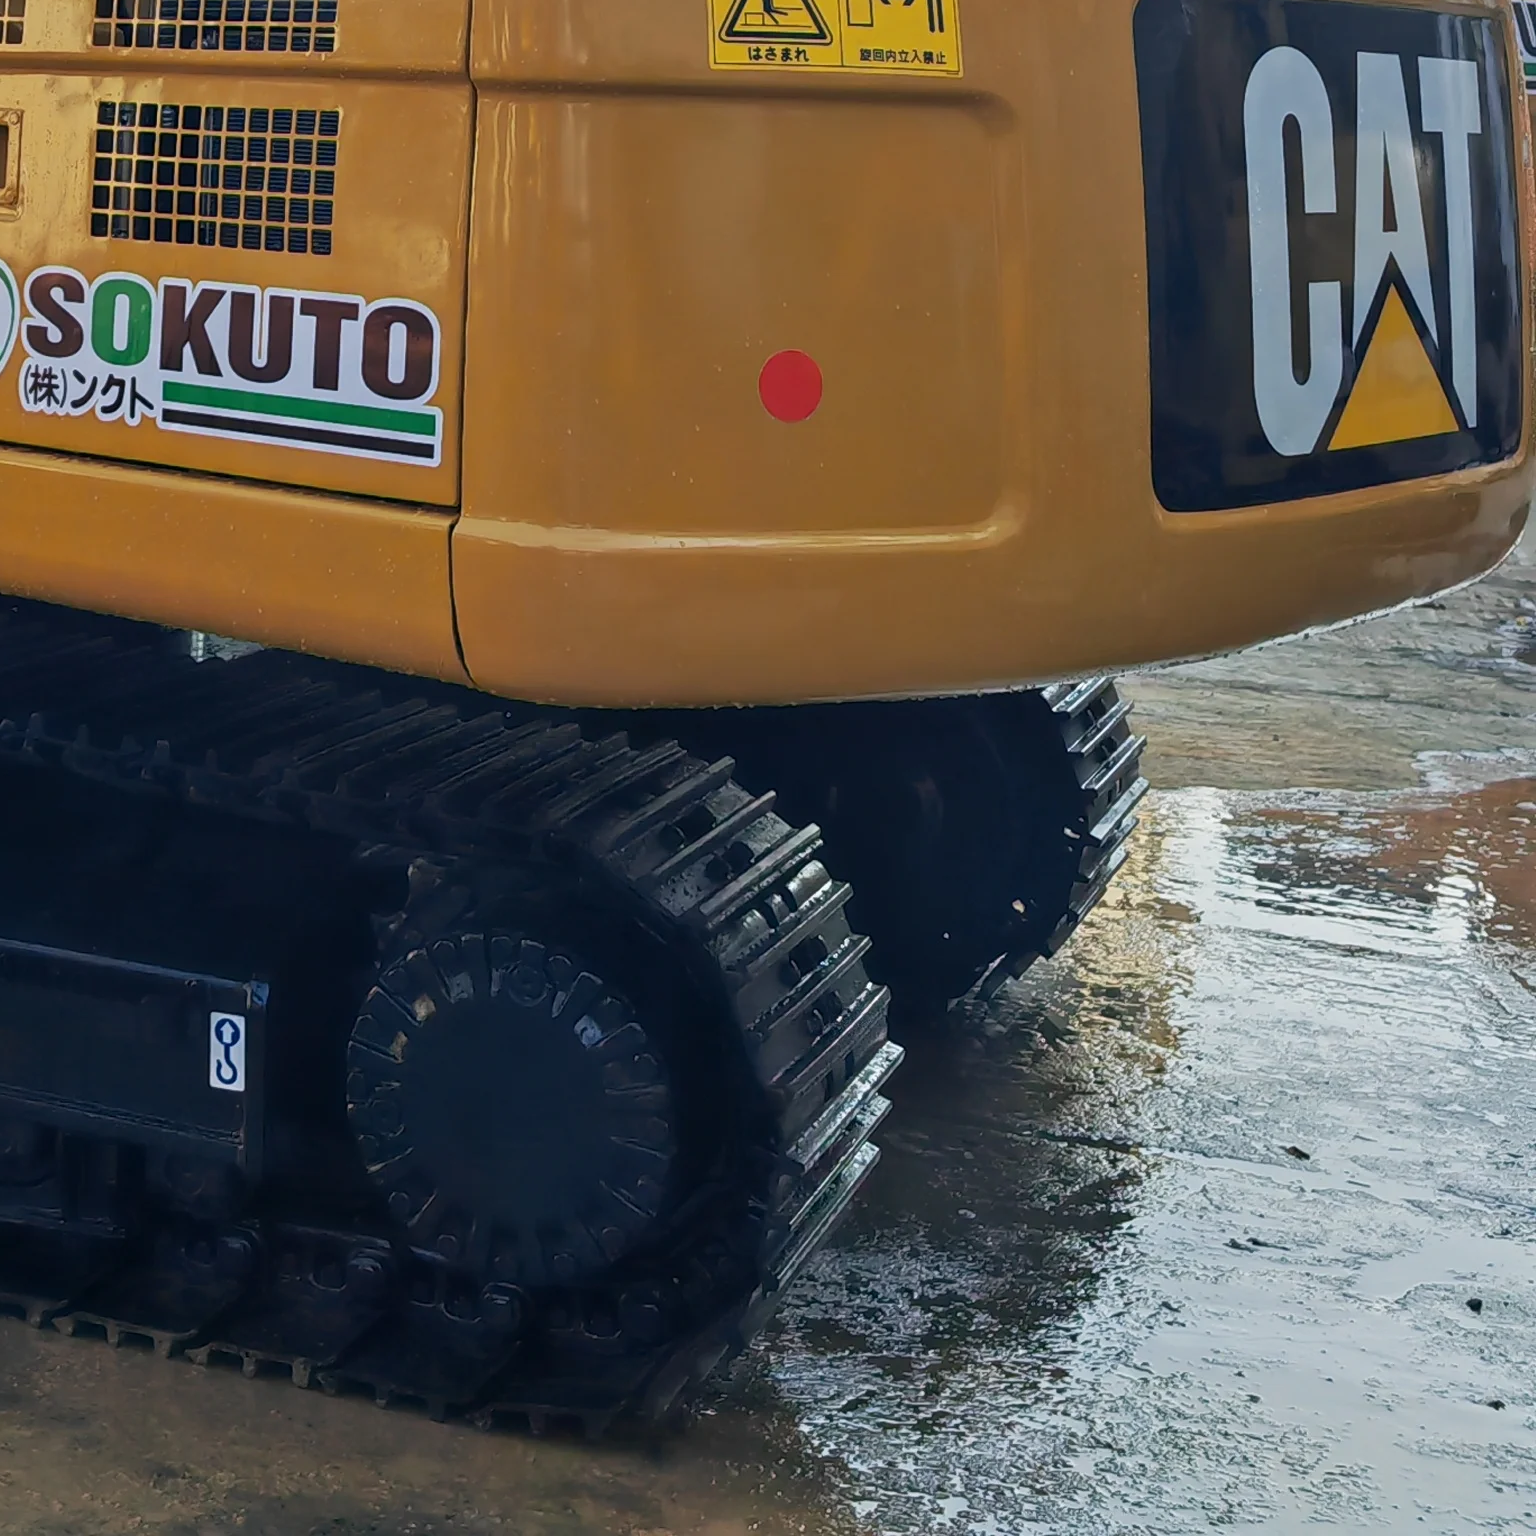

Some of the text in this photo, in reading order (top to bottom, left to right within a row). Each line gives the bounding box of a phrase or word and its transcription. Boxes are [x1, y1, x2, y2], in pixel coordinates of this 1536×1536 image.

[748, 46, 810, 63] はさまれ
[1243, 45, 1482, 458] CAT
[24, 271, 433, 401] SOKUTO
